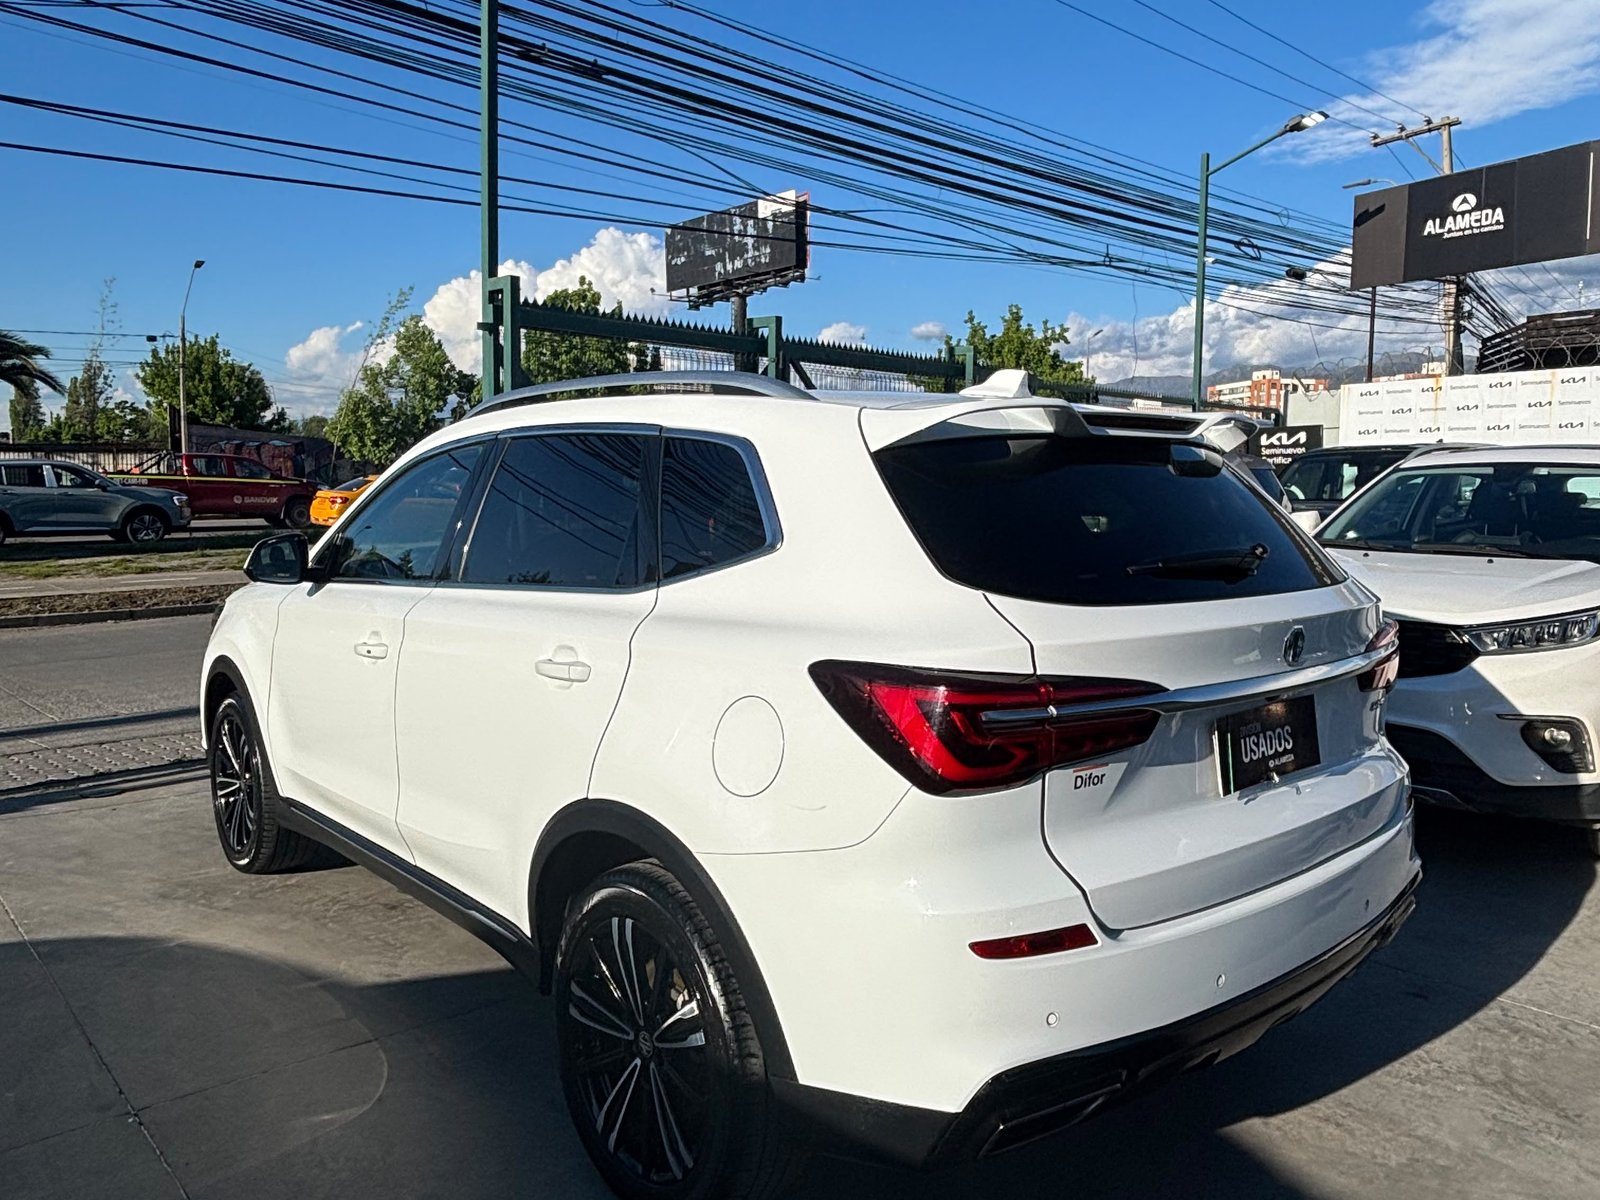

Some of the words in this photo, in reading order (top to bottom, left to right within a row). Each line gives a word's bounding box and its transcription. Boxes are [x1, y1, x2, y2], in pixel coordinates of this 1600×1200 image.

[1423, 207, 1505, 236] ALAMEDA
[1260, 431, 1307, 446] KIA
[1261, 447, 1306, 455] Seminuevos
[1261, 456, 1292, 464] rtifica
[1240, 725, 1293, 763] USADOS
[1073, 772, 1106, 790] Difor
